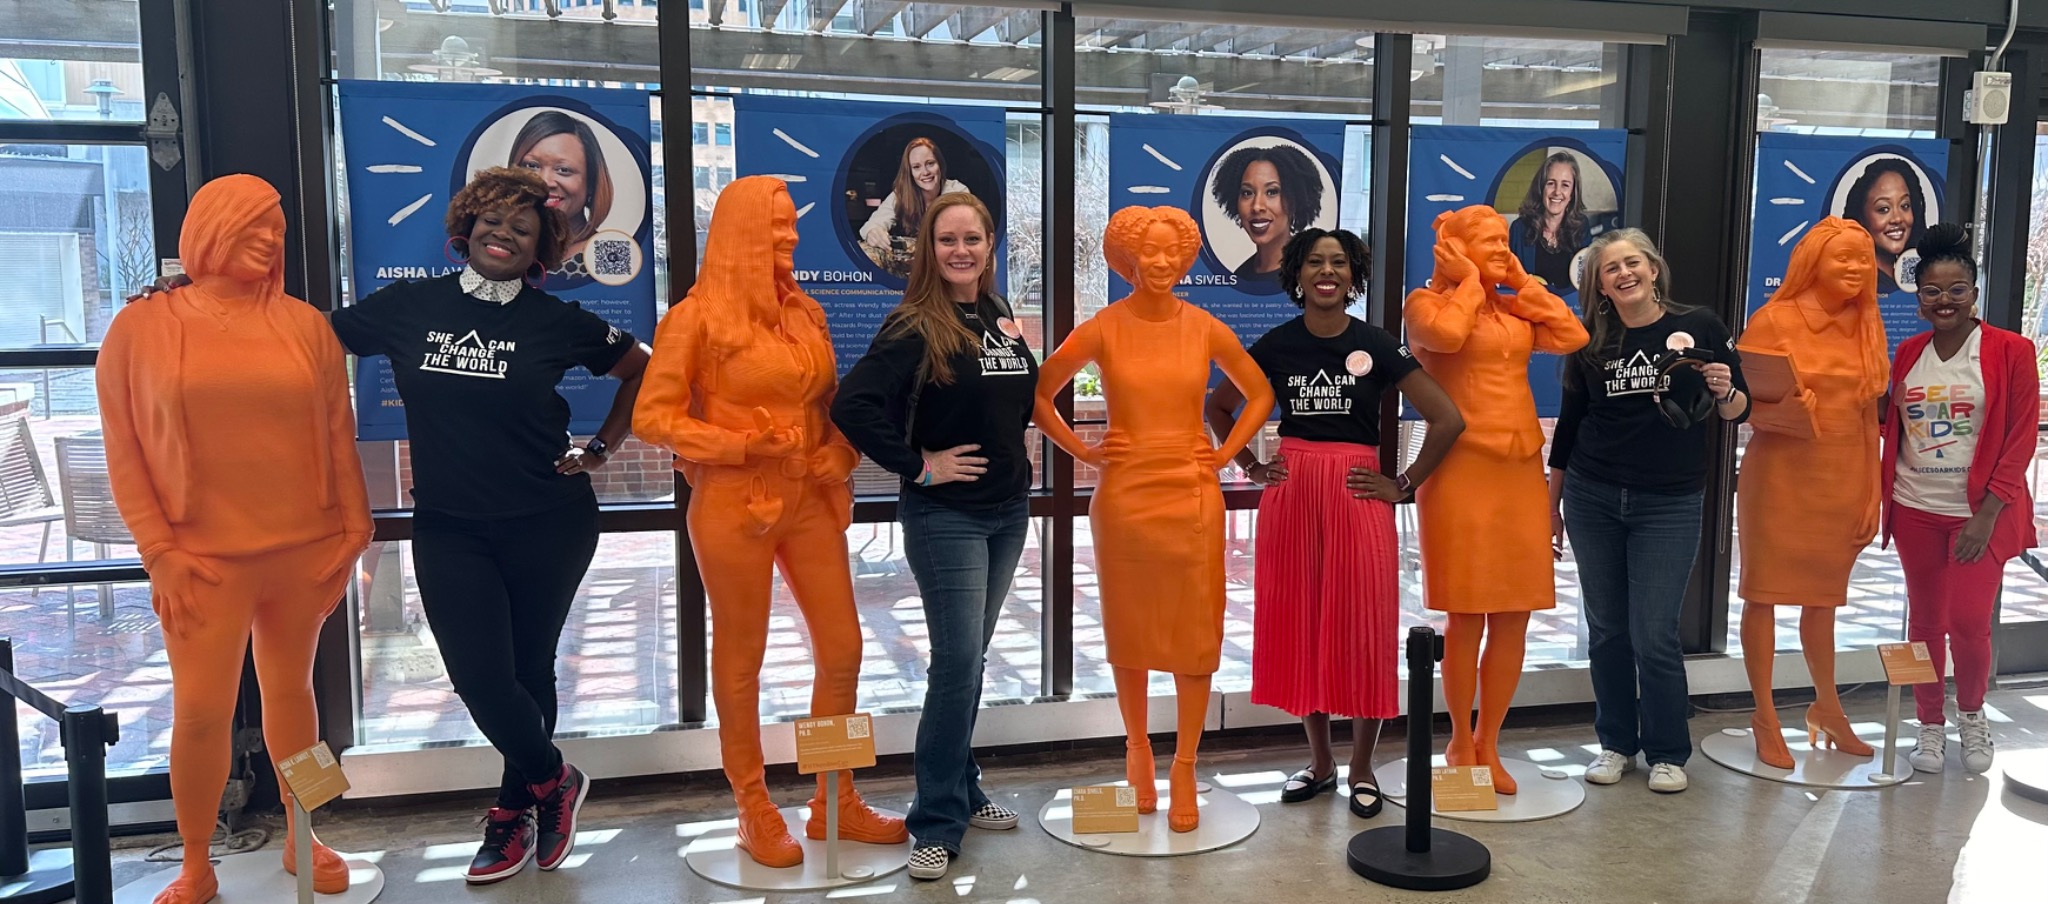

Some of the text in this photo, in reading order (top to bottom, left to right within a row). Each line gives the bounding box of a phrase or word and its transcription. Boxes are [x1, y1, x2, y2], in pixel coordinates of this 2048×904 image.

[376, 266, 427, 278] AISHA
[791, 270, 872, 282] NDY BOHON
[1195, 275, 1238, 285] SIVELS
[426, 331, 516, 353] SHE CAN
[439, 343, 497, 359] CHANGE
[423, 353, 508, 374] THE WORLD
[978, 357, 1029, 370] THE WORLD
[1604, 358, 1625, 370] SHE
[1287, 374, 1356, 387] SHE CAN
[1604, 375, 1671, 392] THE WORD
[1299, 385, 1342, 398] CHANGE
[1904, 384, 1975, 403] SEE
[1289, 397, 1353, 411] THE WORLD
[1906, 402, 1976, 420] SOAR
[1908, 420, 1974, 439] KIDS
